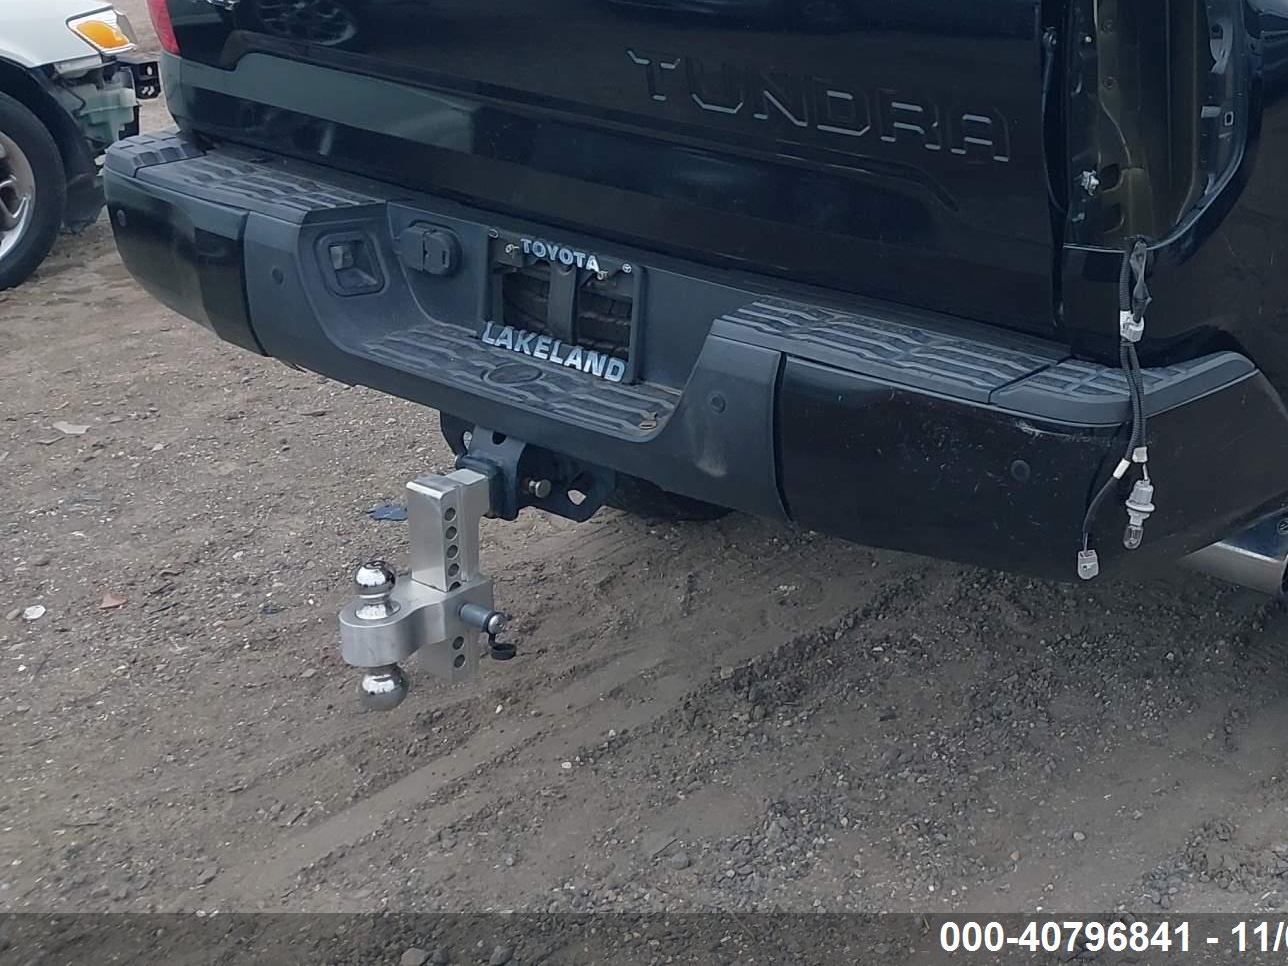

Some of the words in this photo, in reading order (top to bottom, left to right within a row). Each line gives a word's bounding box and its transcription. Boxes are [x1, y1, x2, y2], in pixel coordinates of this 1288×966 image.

[626, 48, 1014, 162] TUNDRA
[520, 238, 600, 272] TOYOTA
[481, 320, 626, 382] LAKELAND
